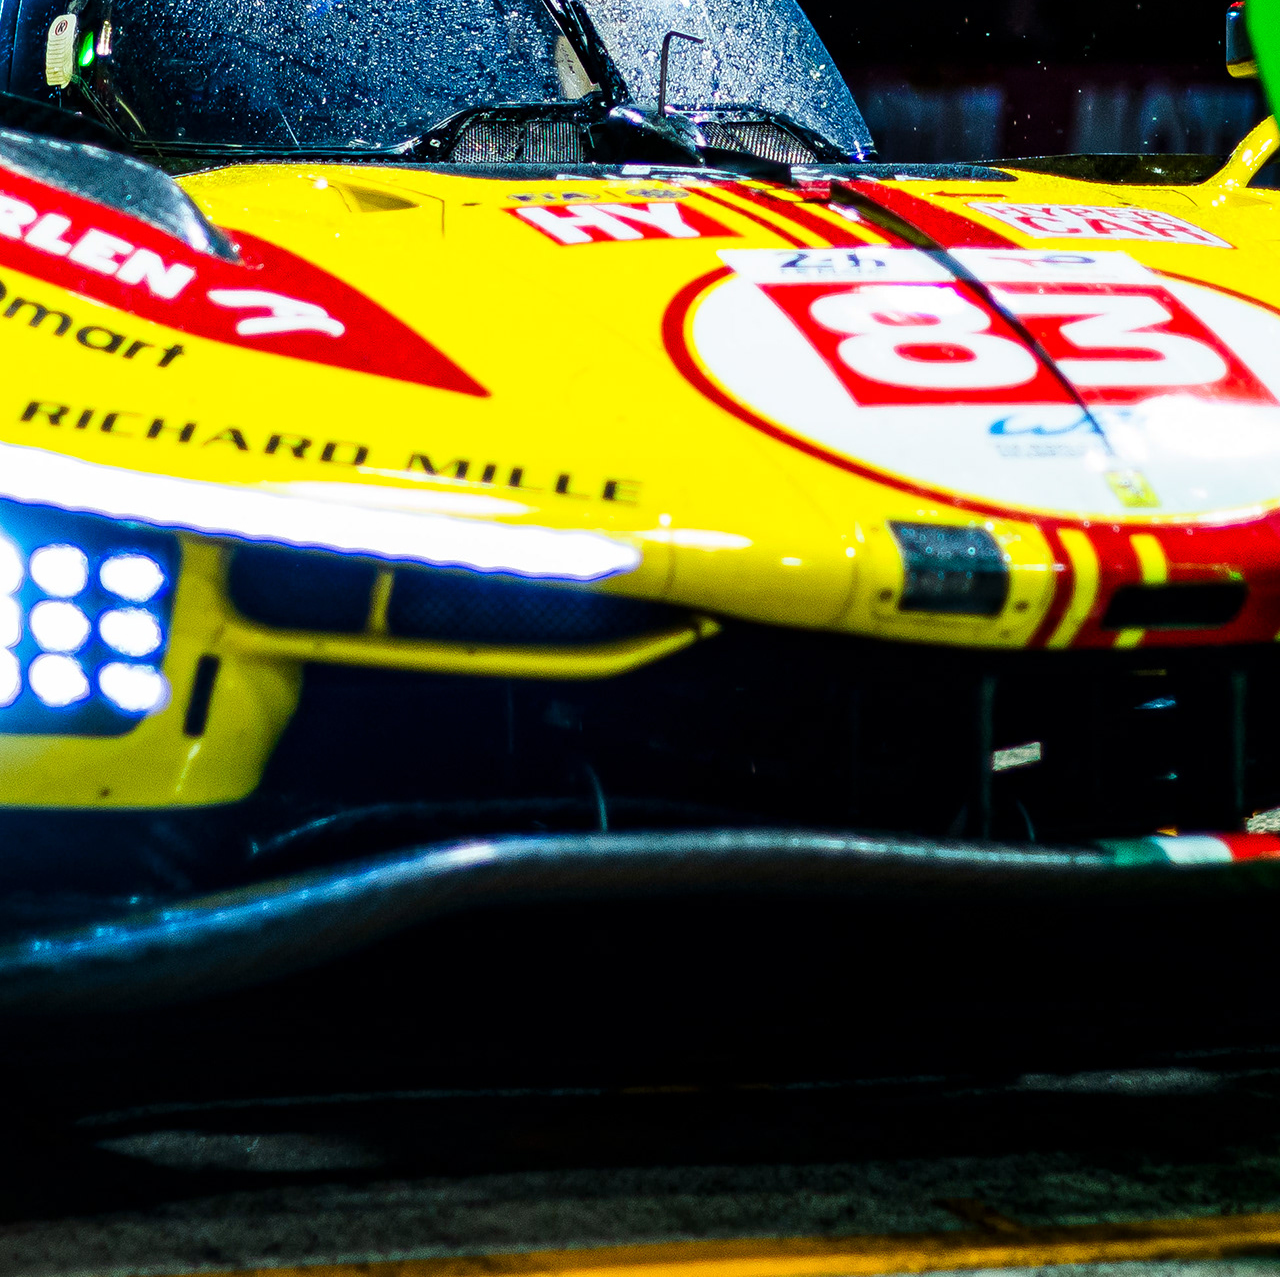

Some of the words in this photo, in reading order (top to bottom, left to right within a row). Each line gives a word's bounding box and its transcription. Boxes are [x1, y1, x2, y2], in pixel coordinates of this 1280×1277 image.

[514, 201, 702, 246] HY
[1014, 216, 1214, 243] CAR
[808, 284, 1228, 389] 83
[20, 400, 370, 468] RICHARD
[405, 452, 645, 509] MILLE
